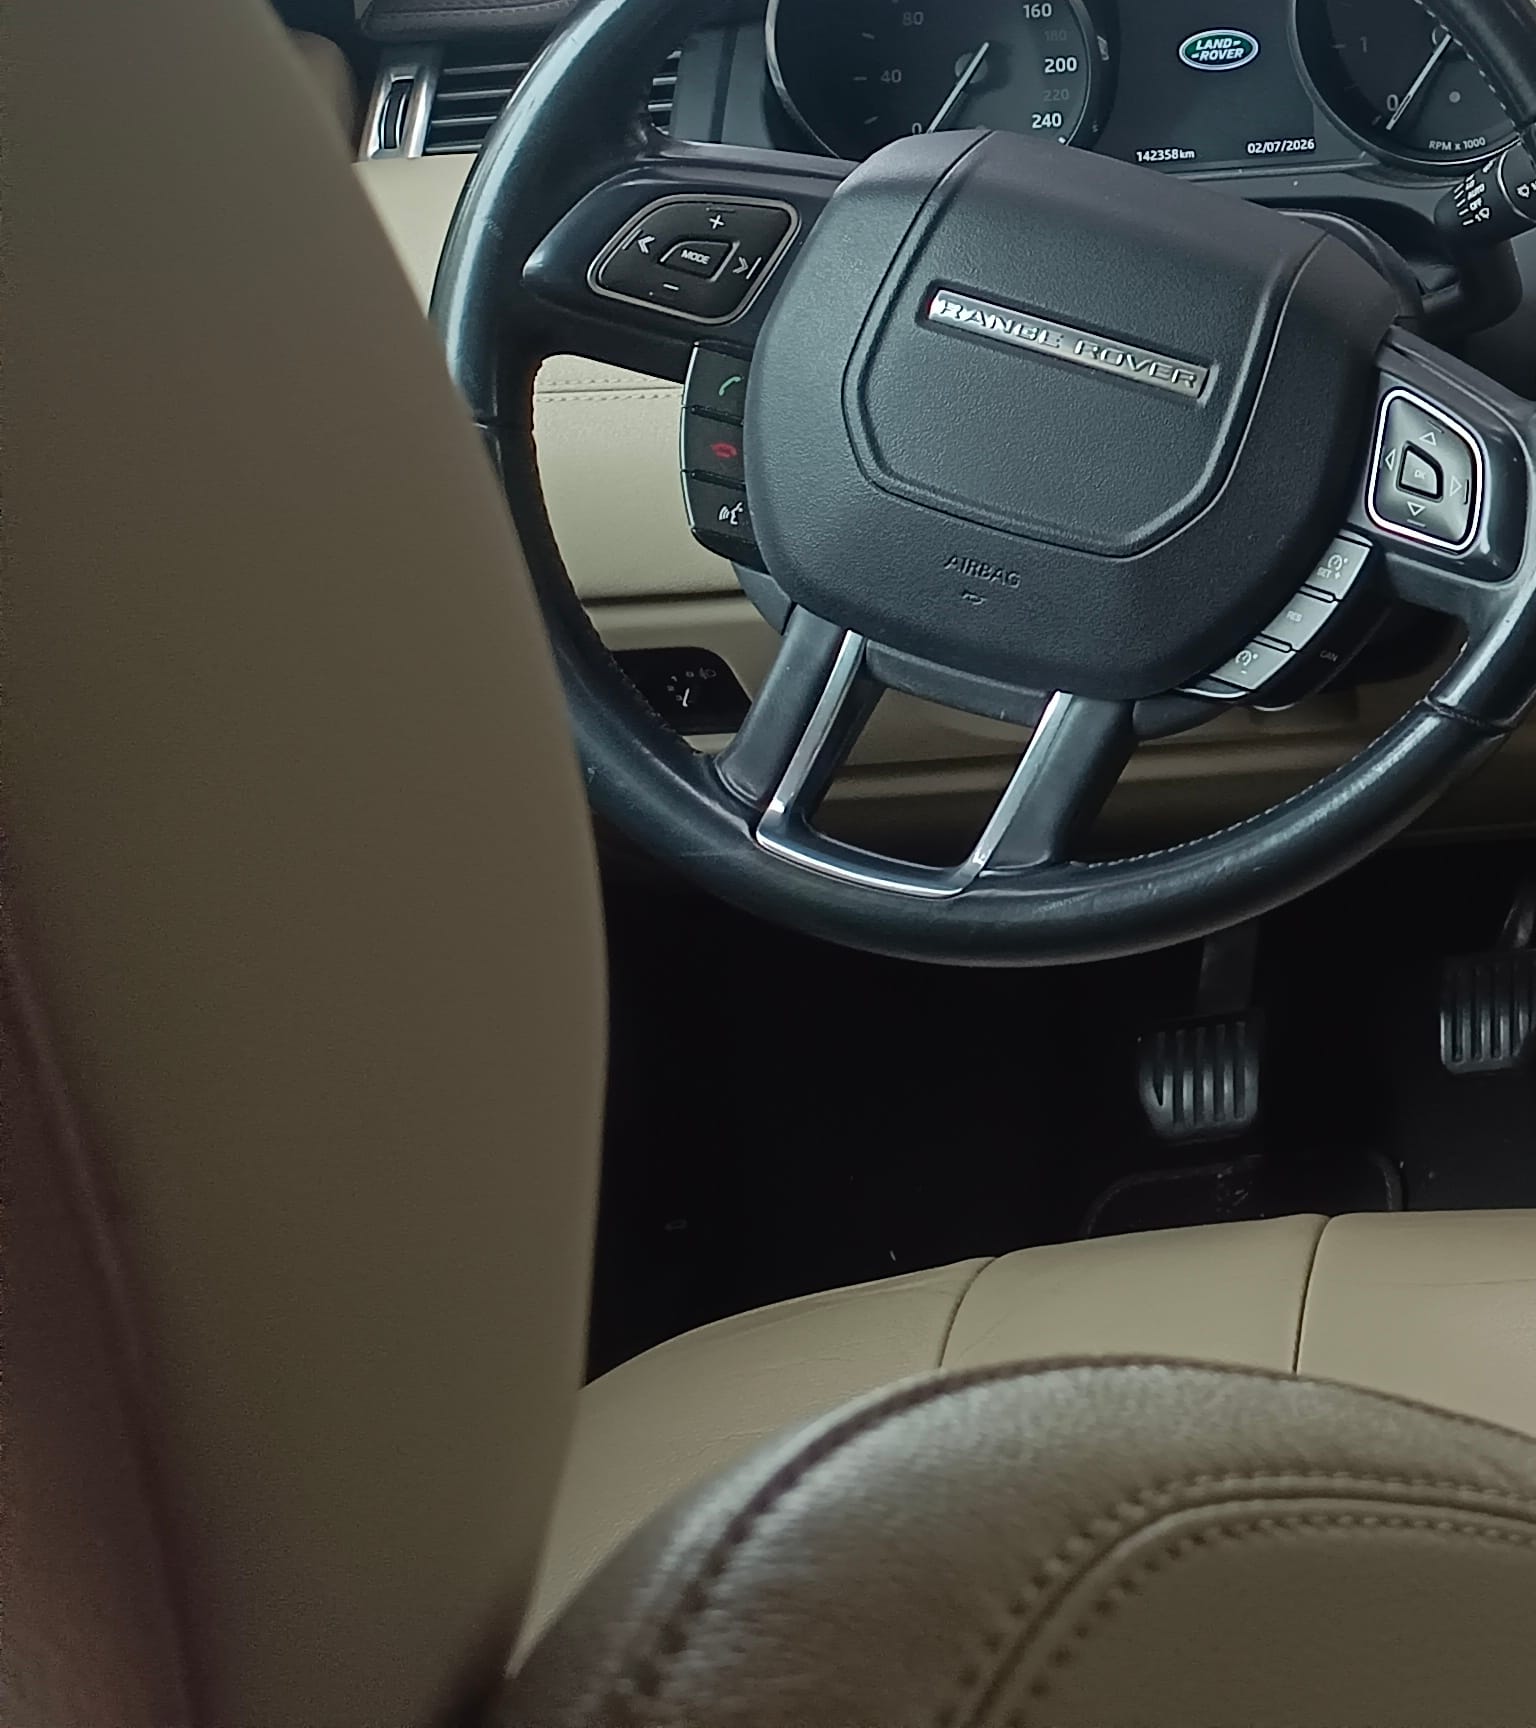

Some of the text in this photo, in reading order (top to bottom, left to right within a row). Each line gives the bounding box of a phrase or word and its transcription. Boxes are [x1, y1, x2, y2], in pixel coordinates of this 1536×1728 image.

[903, 11, 925, 26] 80
[1023, 3, 1053, 19] 160
[1196, 37, 1233, 51] LAND
[1200, 47, 1244, 61] ROVER
[1044, 56, 1078, 74] 200
[880, 68, 902, 84] 40
[1043, 88, 1070, 102] 220
[1386, 94, 1399, 112] 0
[1031, 112, 1063, 129] 240
[1247, 138, 1315, 154] 02/07/2026
[1429, 140, 1451, 150] RPM
[1463, 136, 1486, 150] 1000
[680, 248, 711, 265] MODE
[1073, 339, 1198, 389] ROVER
[943, 554, 1021, 589] AIRBAG
